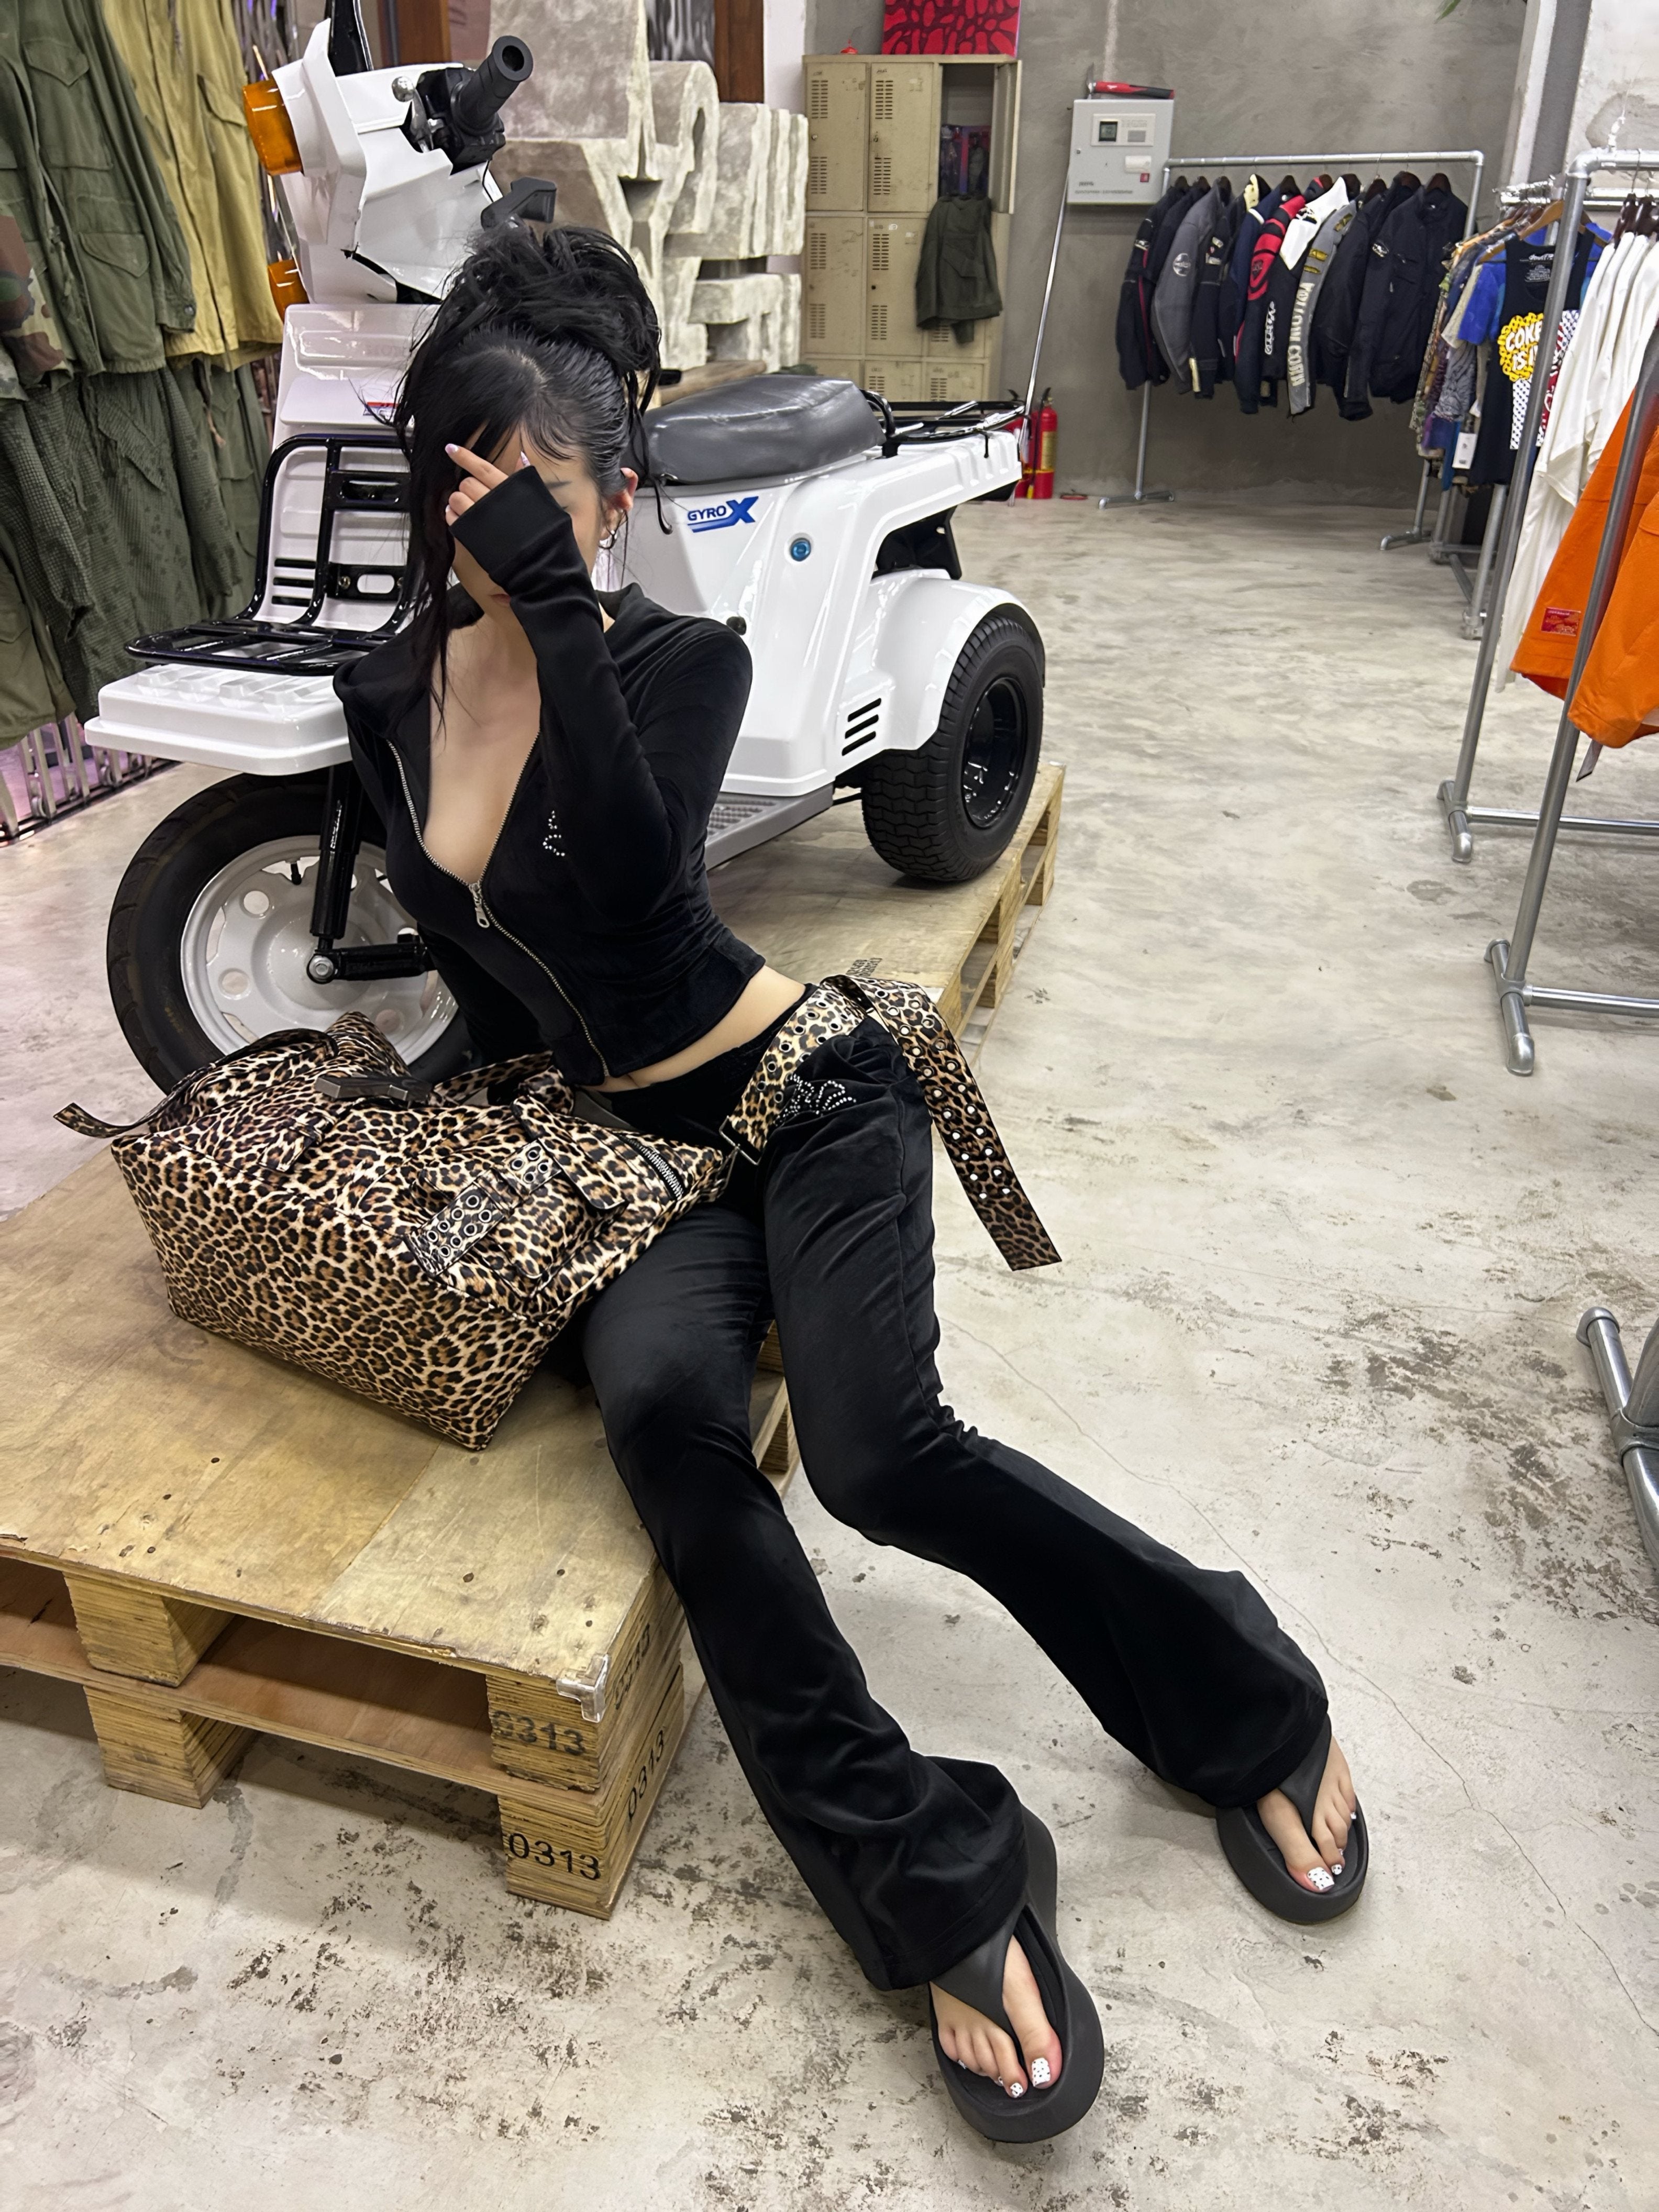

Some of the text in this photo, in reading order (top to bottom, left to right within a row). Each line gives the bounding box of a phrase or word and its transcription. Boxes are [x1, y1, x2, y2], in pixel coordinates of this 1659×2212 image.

[1512, 351, 1528, 371] IS
[687, 496, 759, 523] GYRO X
[492, 1710, 586, 1757] 0313
[626, 1729, 666, 1822] 0313
[507, 1832, 602, 1881] 0313
